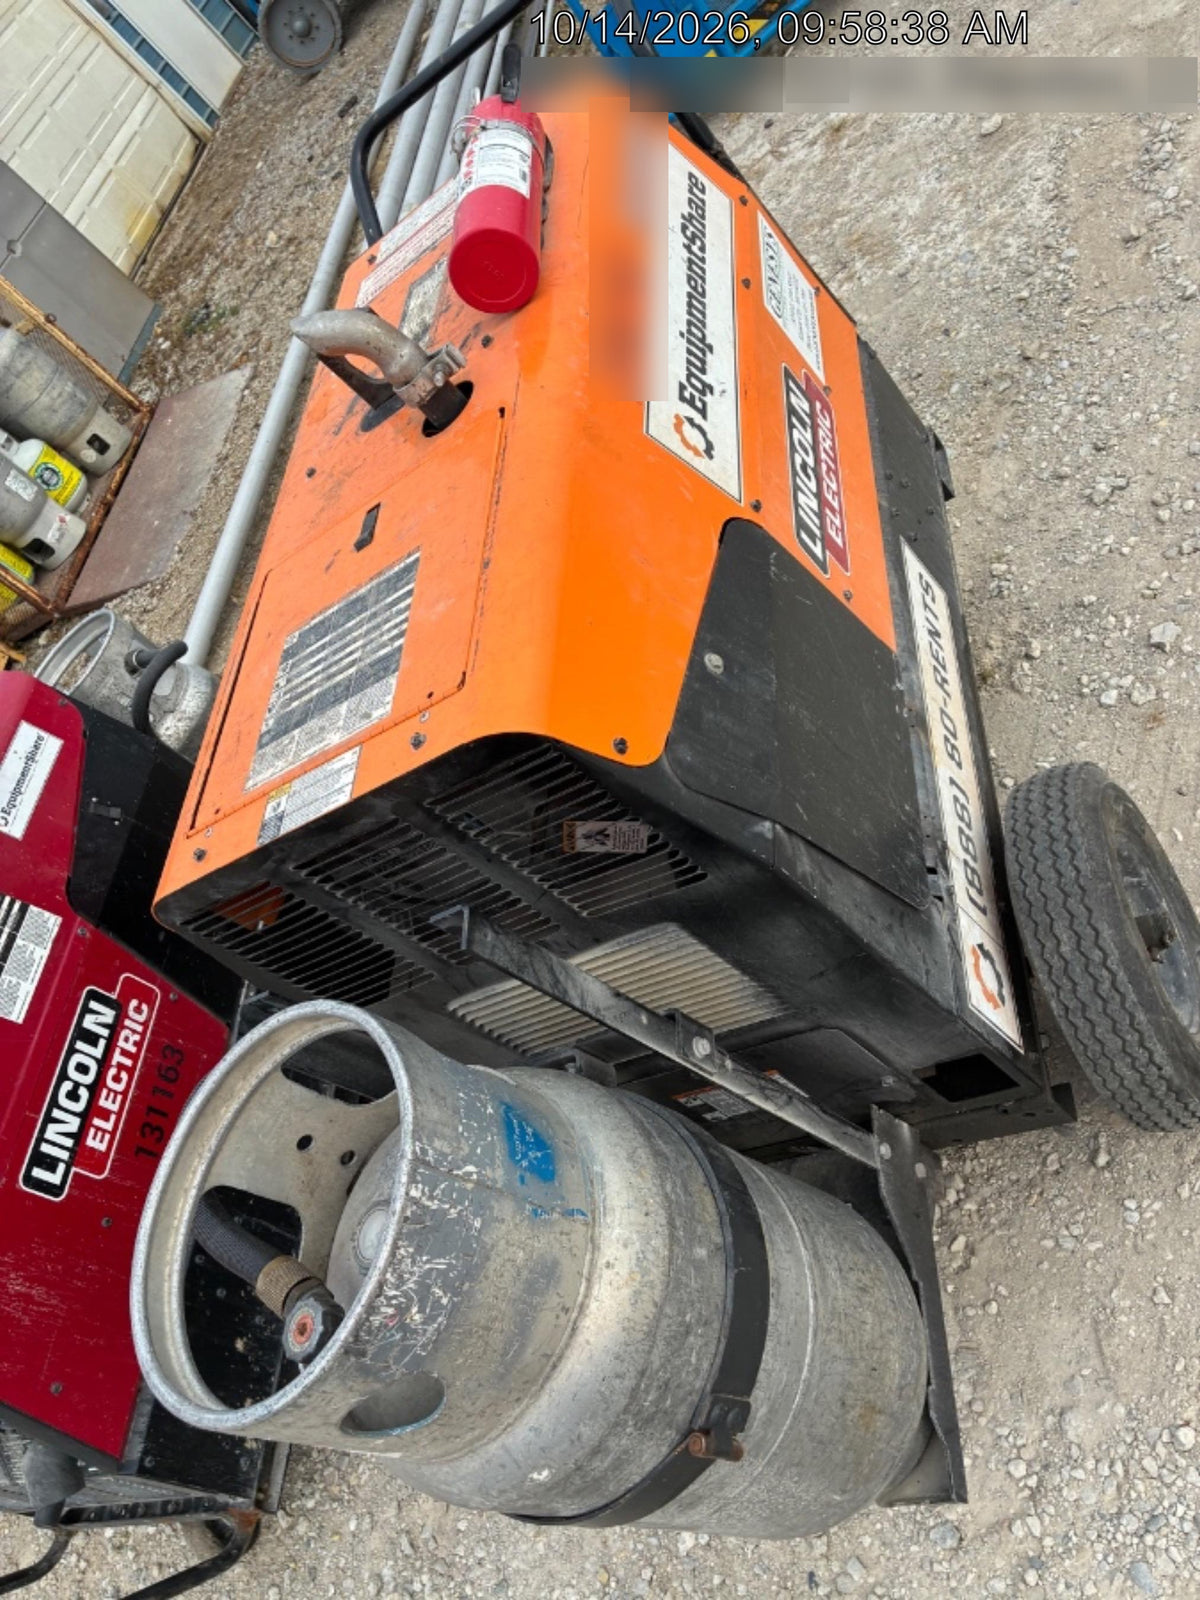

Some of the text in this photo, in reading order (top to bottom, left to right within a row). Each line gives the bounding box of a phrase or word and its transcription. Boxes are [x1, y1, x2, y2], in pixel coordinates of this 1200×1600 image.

[679, 171, 713, 421] EquipmentShare
[789, 380, 823, 562] LINCOLN
[816, 399, 843, 548] ELECTRIC
[919, 571, 988, 917] (888) 80-RENTS
[31, 999, 117, 1186] LINCOLN
[86, 998, 150, 1153] ELECTRIC
[135, 1044, 185, 1159] 131163
